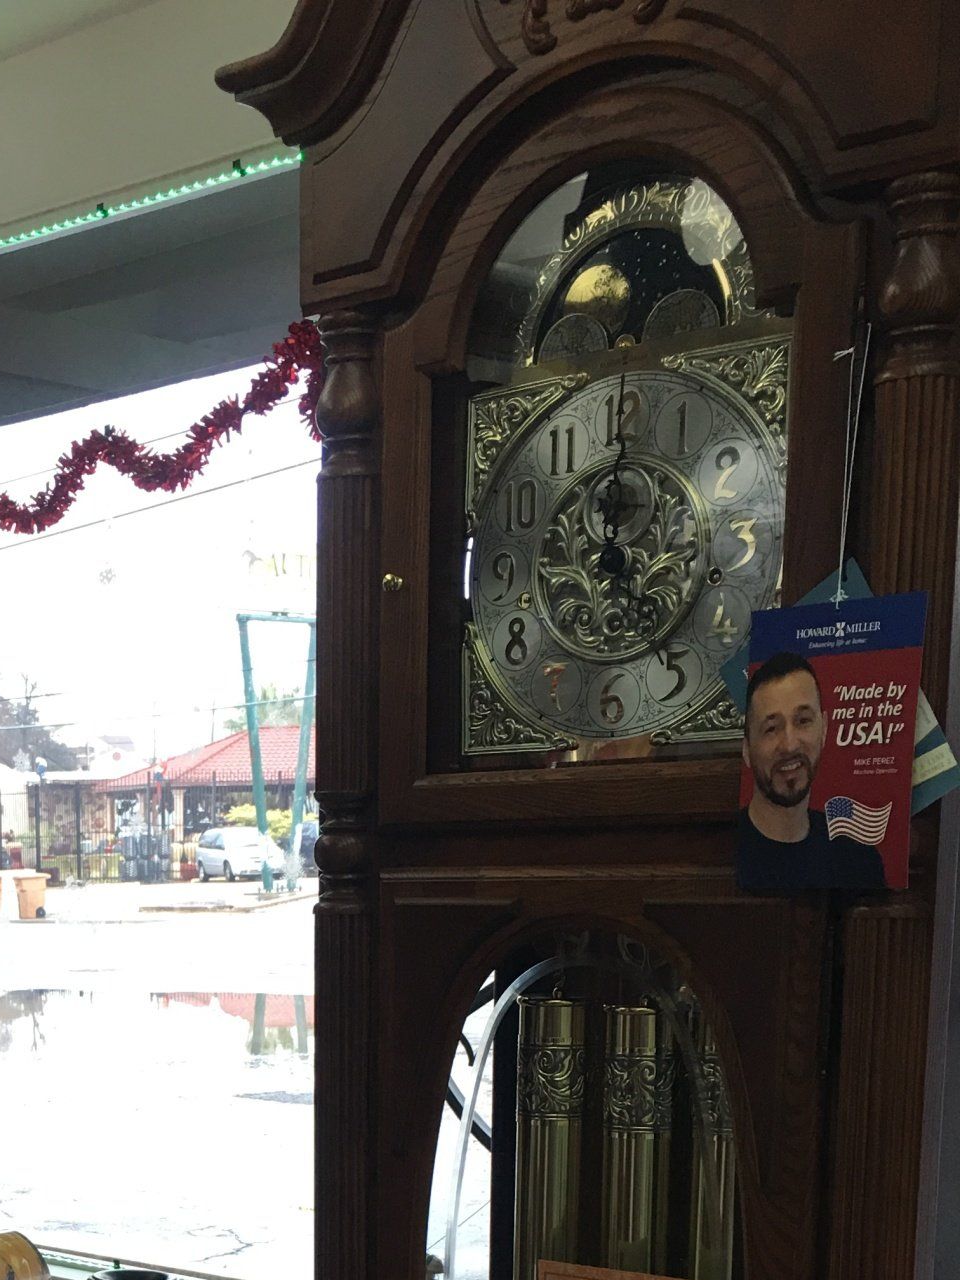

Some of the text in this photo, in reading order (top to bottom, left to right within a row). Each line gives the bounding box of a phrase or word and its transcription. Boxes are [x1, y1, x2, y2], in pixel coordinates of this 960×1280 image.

[604, 390, 641, 447] 12
[677, 399, 688, 456] 1
[549, 422, 578, 476] 11
[714, 446, 741, 500] 2
[505, 481, 537, 533] 10
[727, 518, 757, 573] 3
[492, 551, 516, 601] 9
[505, 616, 527, 666] 8
[706, 592, 738, 644] 4
[796, 621, 881, 639] HOWARD MILLER
[543, 661, 569, 712] 7
[599, 673, 625, 724] 6
[663, 647, 688, 702] 5
[886, 682, 907, 701] by
[832, 697, 902, 721] me in the
[854, 758, 872, 766] MIKE
